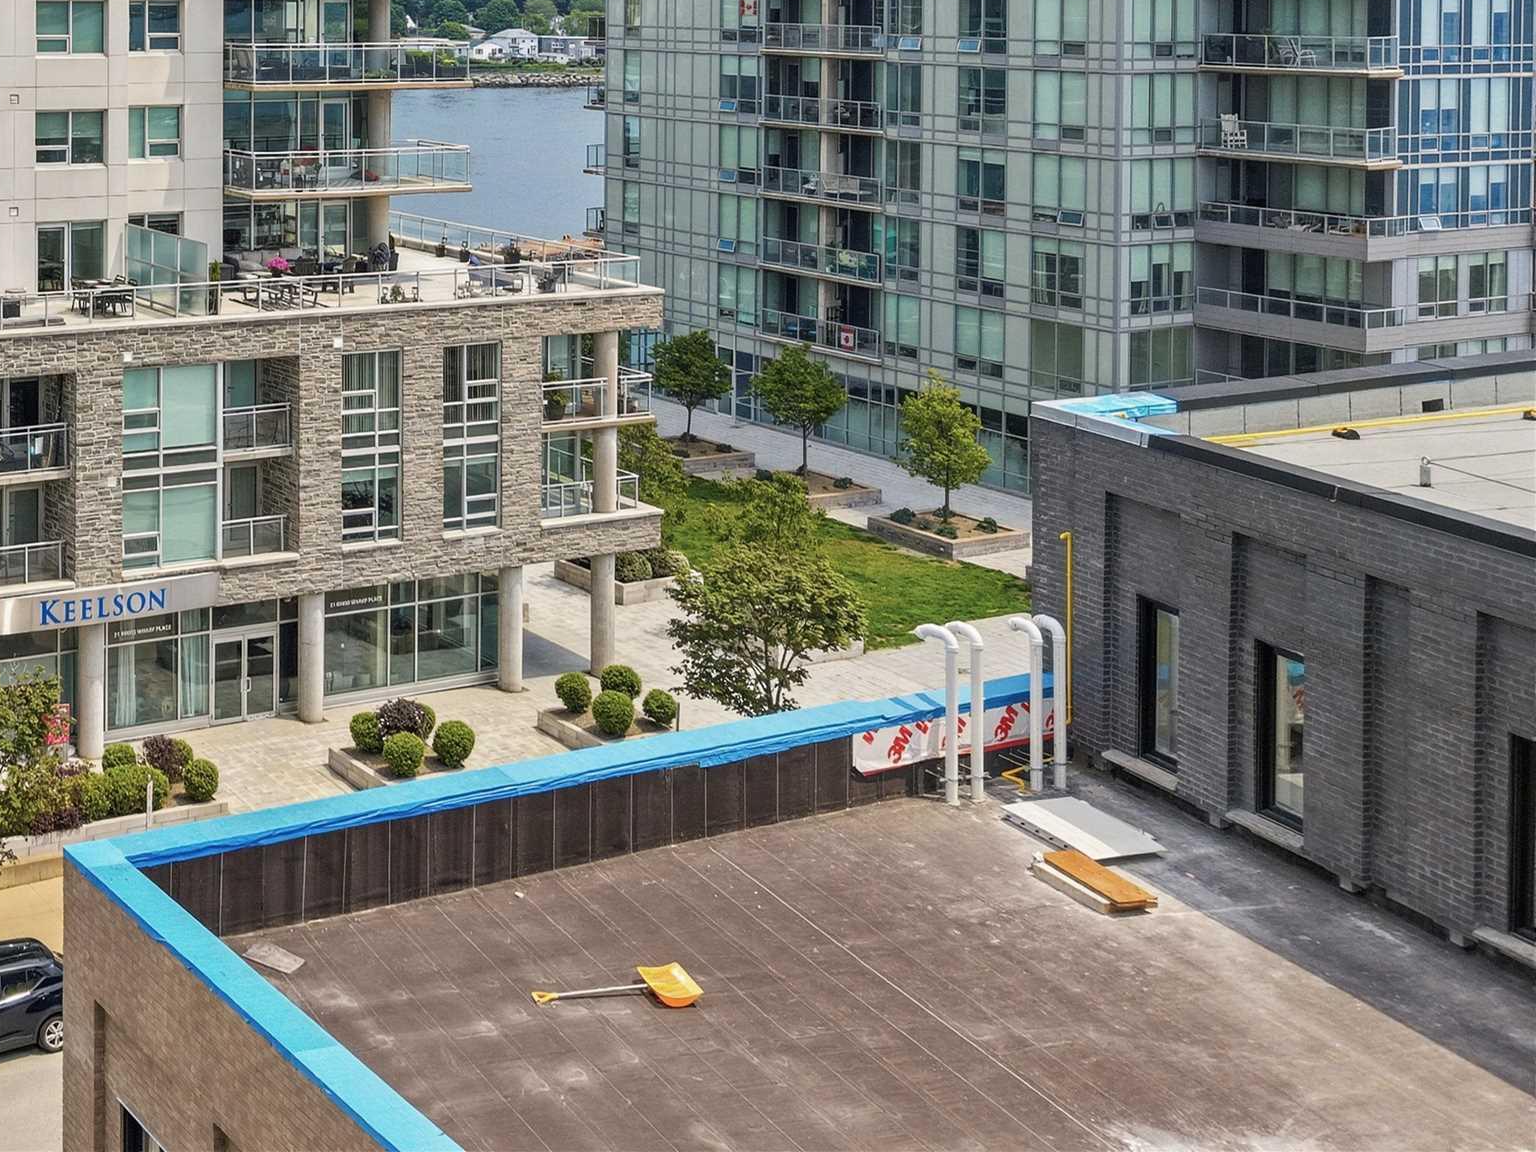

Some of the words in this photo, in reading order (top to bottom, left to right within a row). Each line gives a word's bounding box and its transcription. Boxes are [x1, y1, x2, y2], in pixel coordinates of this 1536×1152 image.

[39, 588, 167, 626] KEELSON
[994, 705, 1019, 742] 3M
[887, 725, 913, 764] 3M
